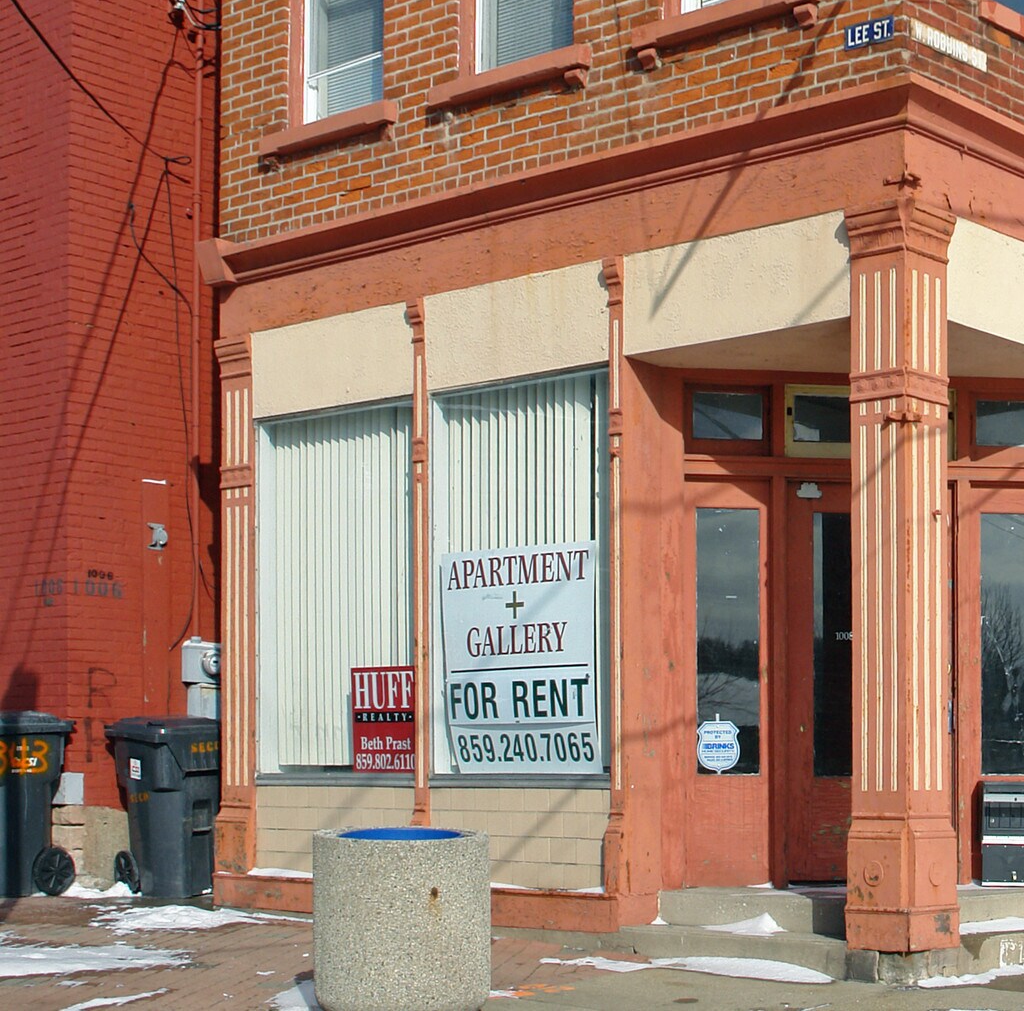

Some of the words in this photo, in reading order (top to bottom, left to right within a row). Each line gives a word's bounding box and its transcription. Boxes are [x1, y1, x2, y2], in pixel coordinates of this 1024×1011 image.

[847, 24, 870, 47] LEE
[873, 19, 891, 40] ST.
[447, 549, 589, 591] APARTMENT
[466, 621, 568, 658] GALLERY
[353, 670, 414, 710] HUFF
[450, 681, 499, 720] FOR
[511, 678, 589, 719] RENT
[362, 712, 408, 723] REALTY
[361, 736, 384, 751] Beth
[385, 736, 412, 751] Prast
[457, 732, 595, 763] 859.240.7065
